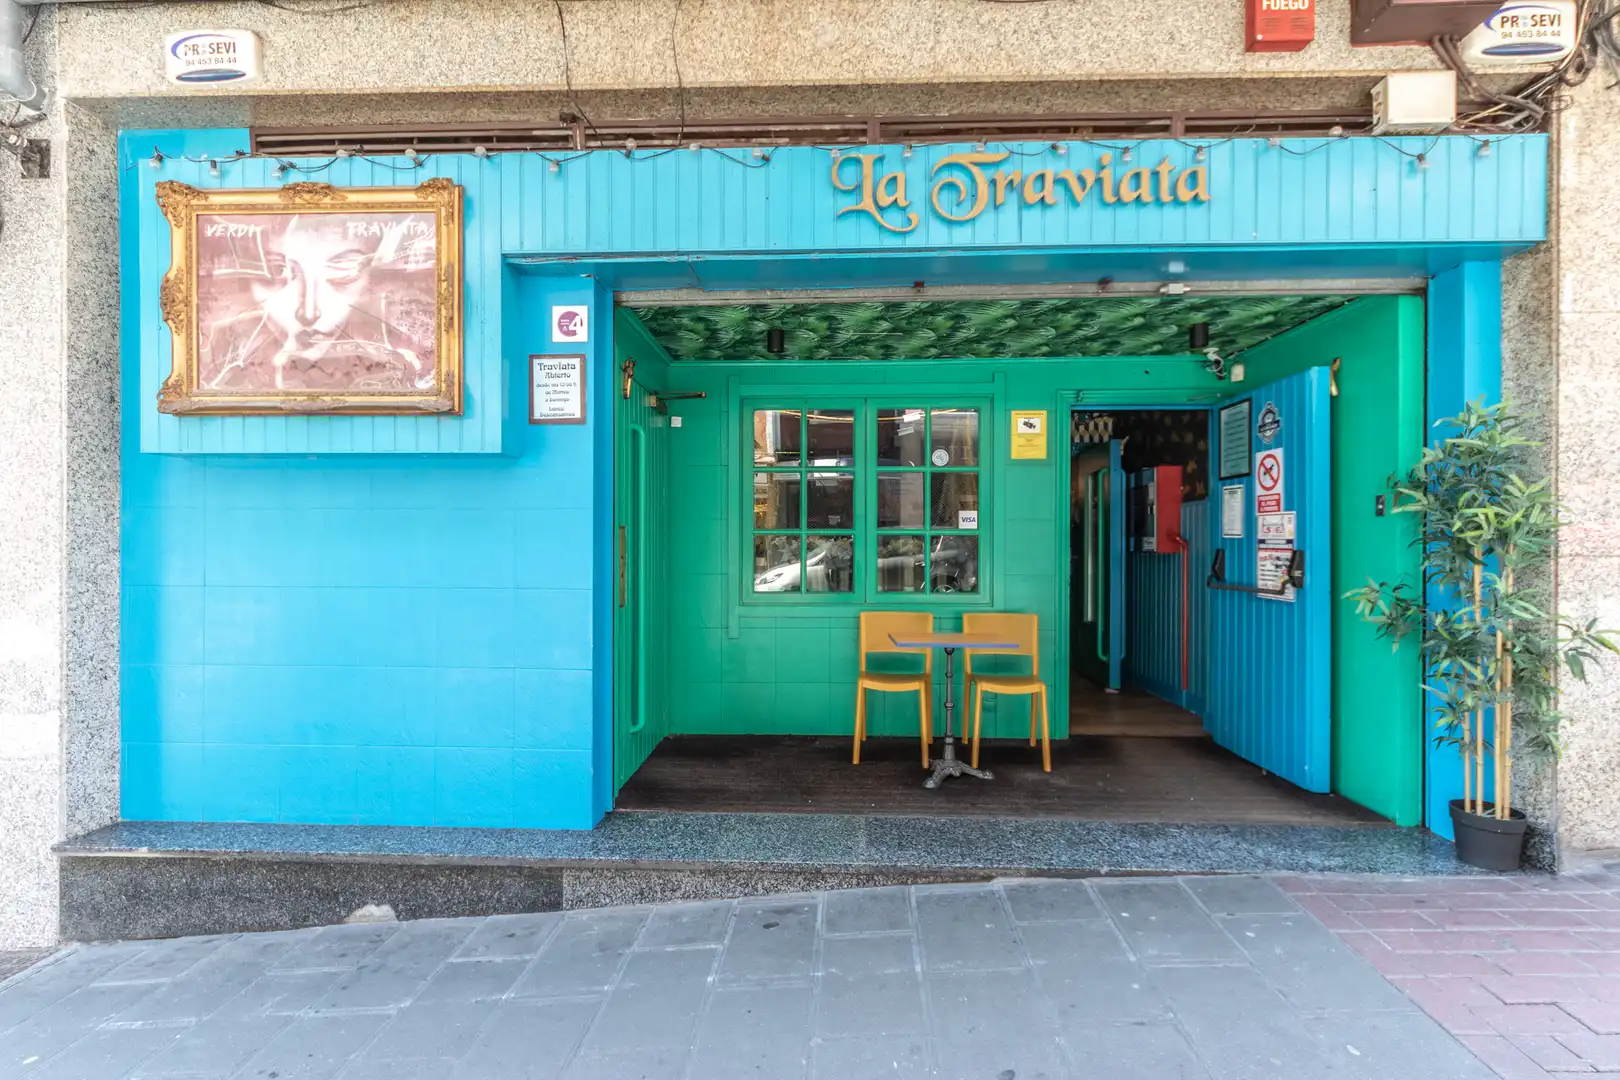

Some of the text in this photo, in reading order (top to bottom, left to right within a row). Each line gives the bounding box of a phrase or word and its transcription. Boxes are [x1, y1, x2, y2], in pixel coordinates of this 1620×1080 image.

[1262, 0, 1309, 11] FUEGO
[1501, 31, 1513, 39] 94
[831, 151, 1212, 233] La Traviata
[537, 362, 576, 371] Traviata
